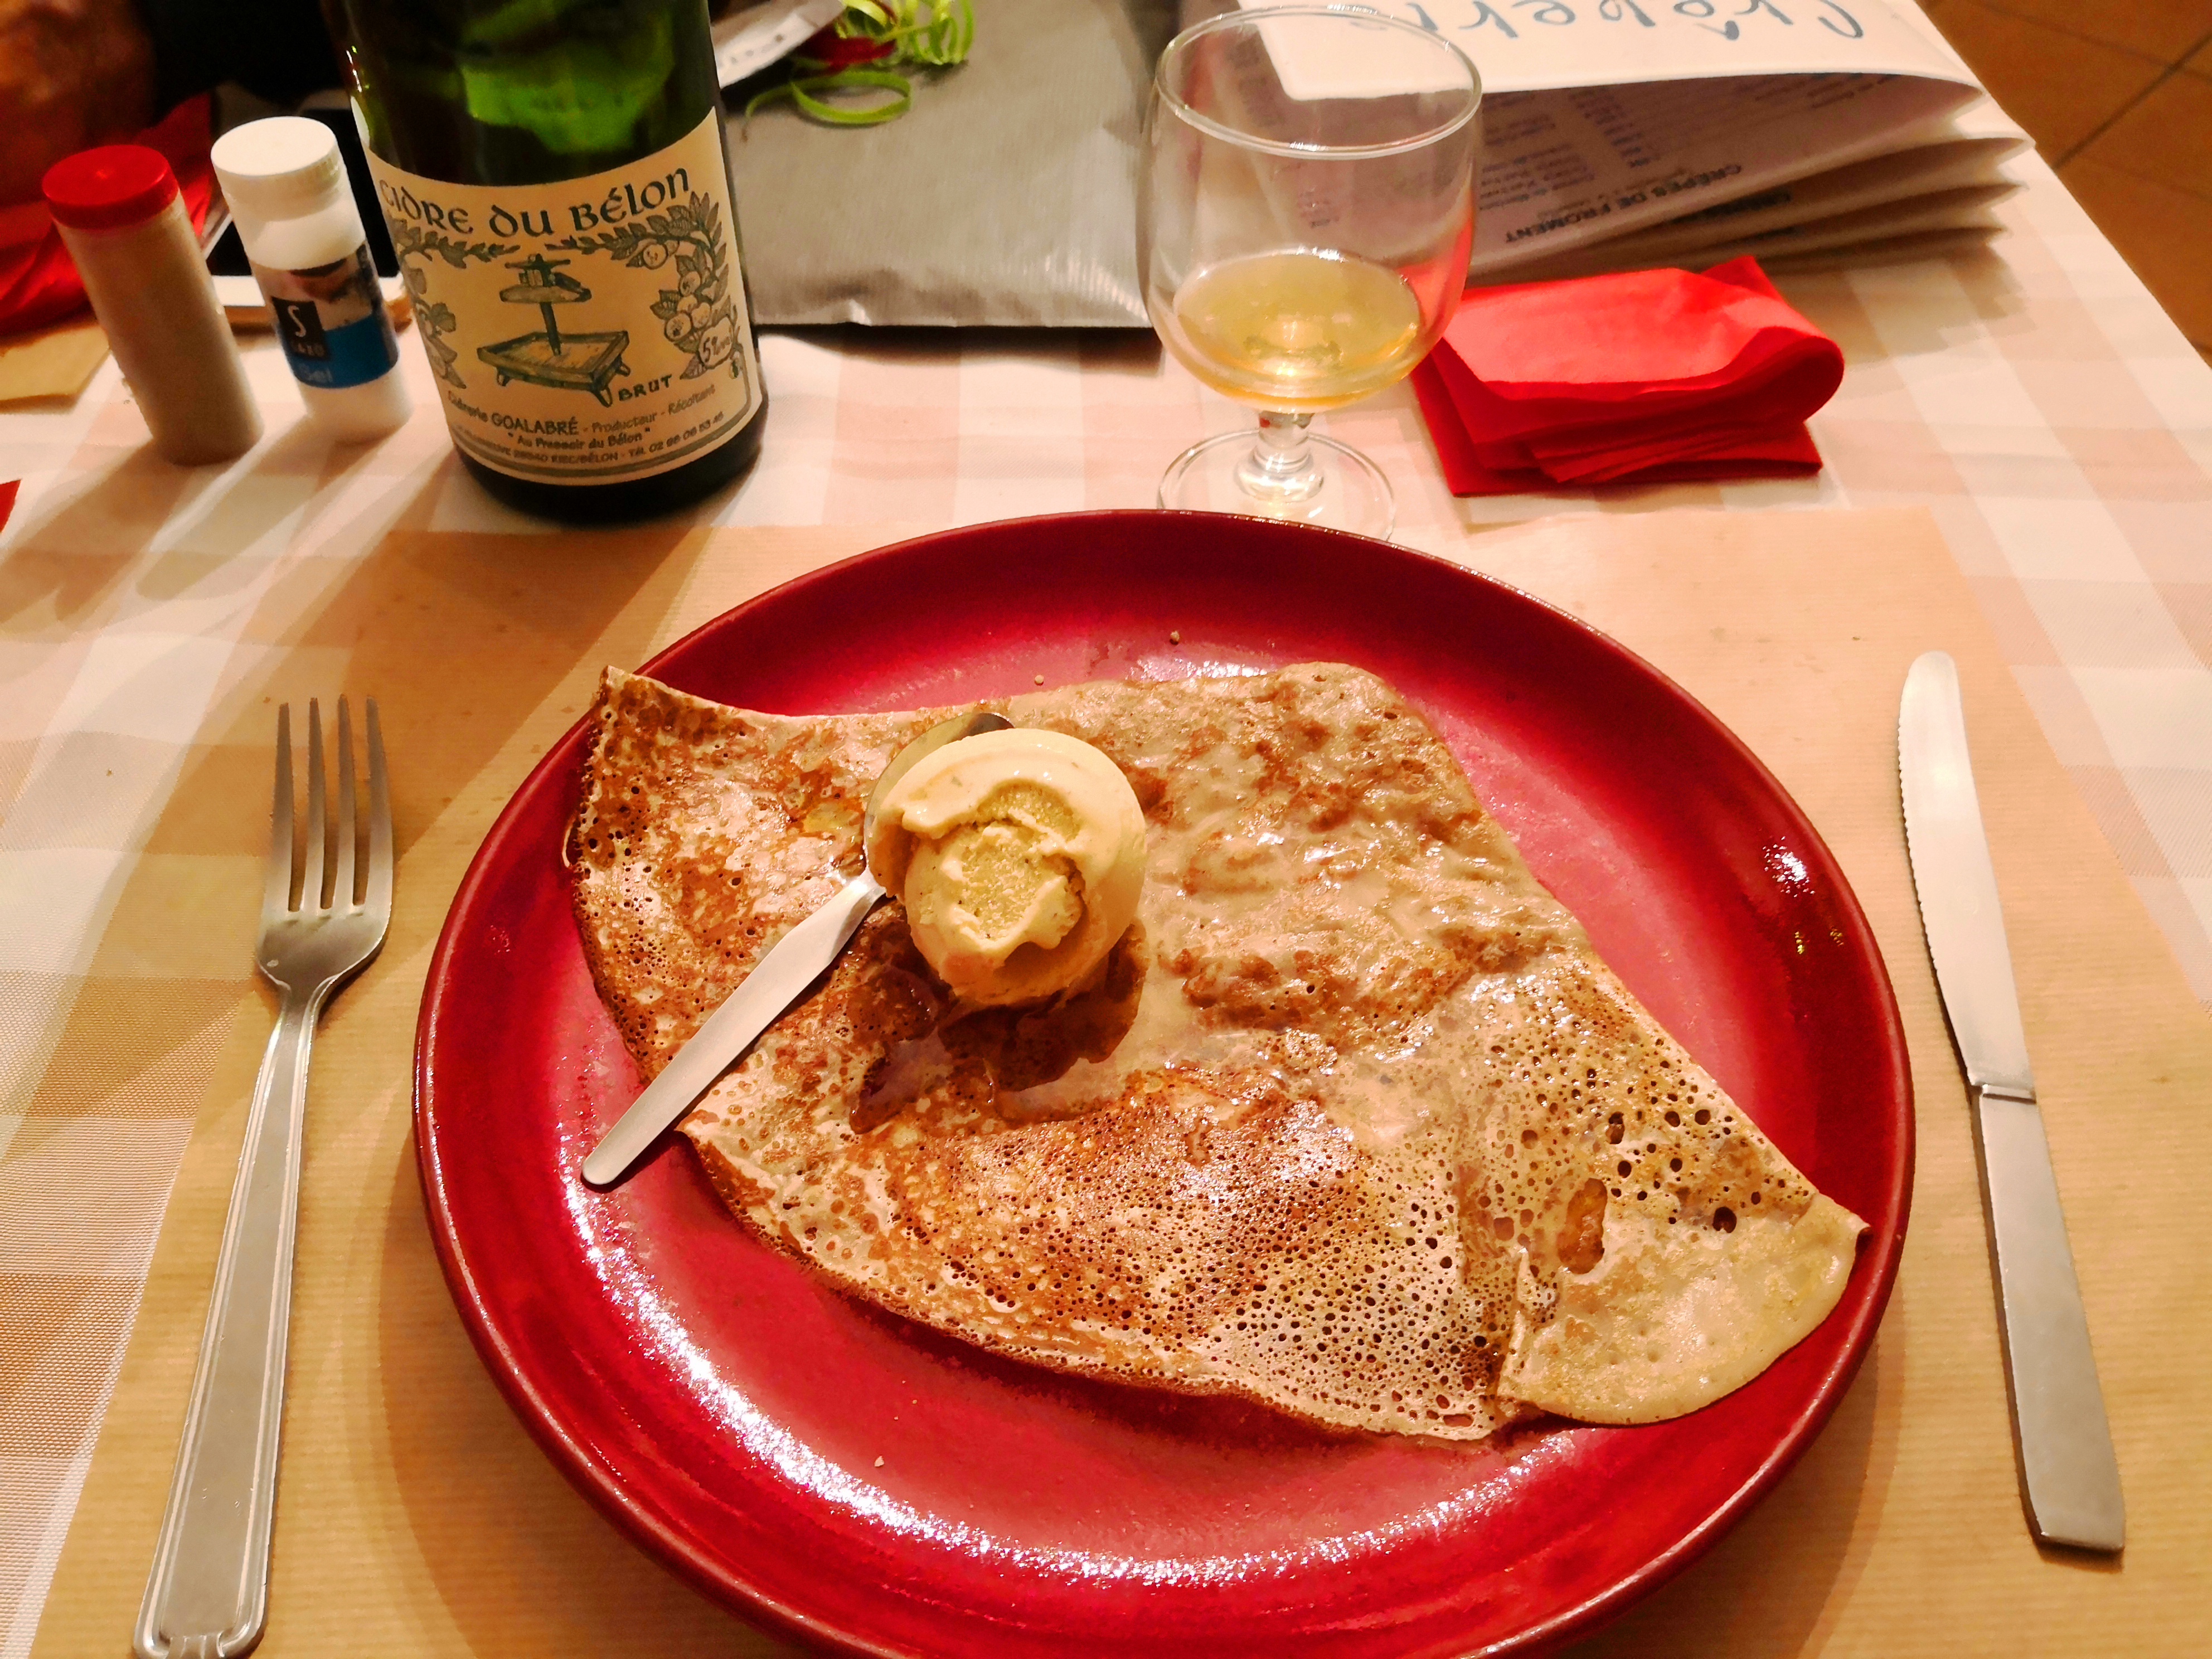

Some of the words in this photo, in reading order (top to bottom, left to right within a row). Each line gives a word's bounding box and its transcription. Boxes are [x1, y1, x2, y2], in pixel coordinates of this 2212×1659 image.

[1652, 164, 1742, 197] CRÊPES
[1617, 191, 1647, 210] DE
[1506, 203, 1611, 244] FROMENT
[287, 304, 307, 337] S
[618, 373, 672, 402] BRUT
[491, 413, 579, 435] GOALABRÉ
[589, 438, 604, 449] du
[608, 431, 643, 447] Bélon
